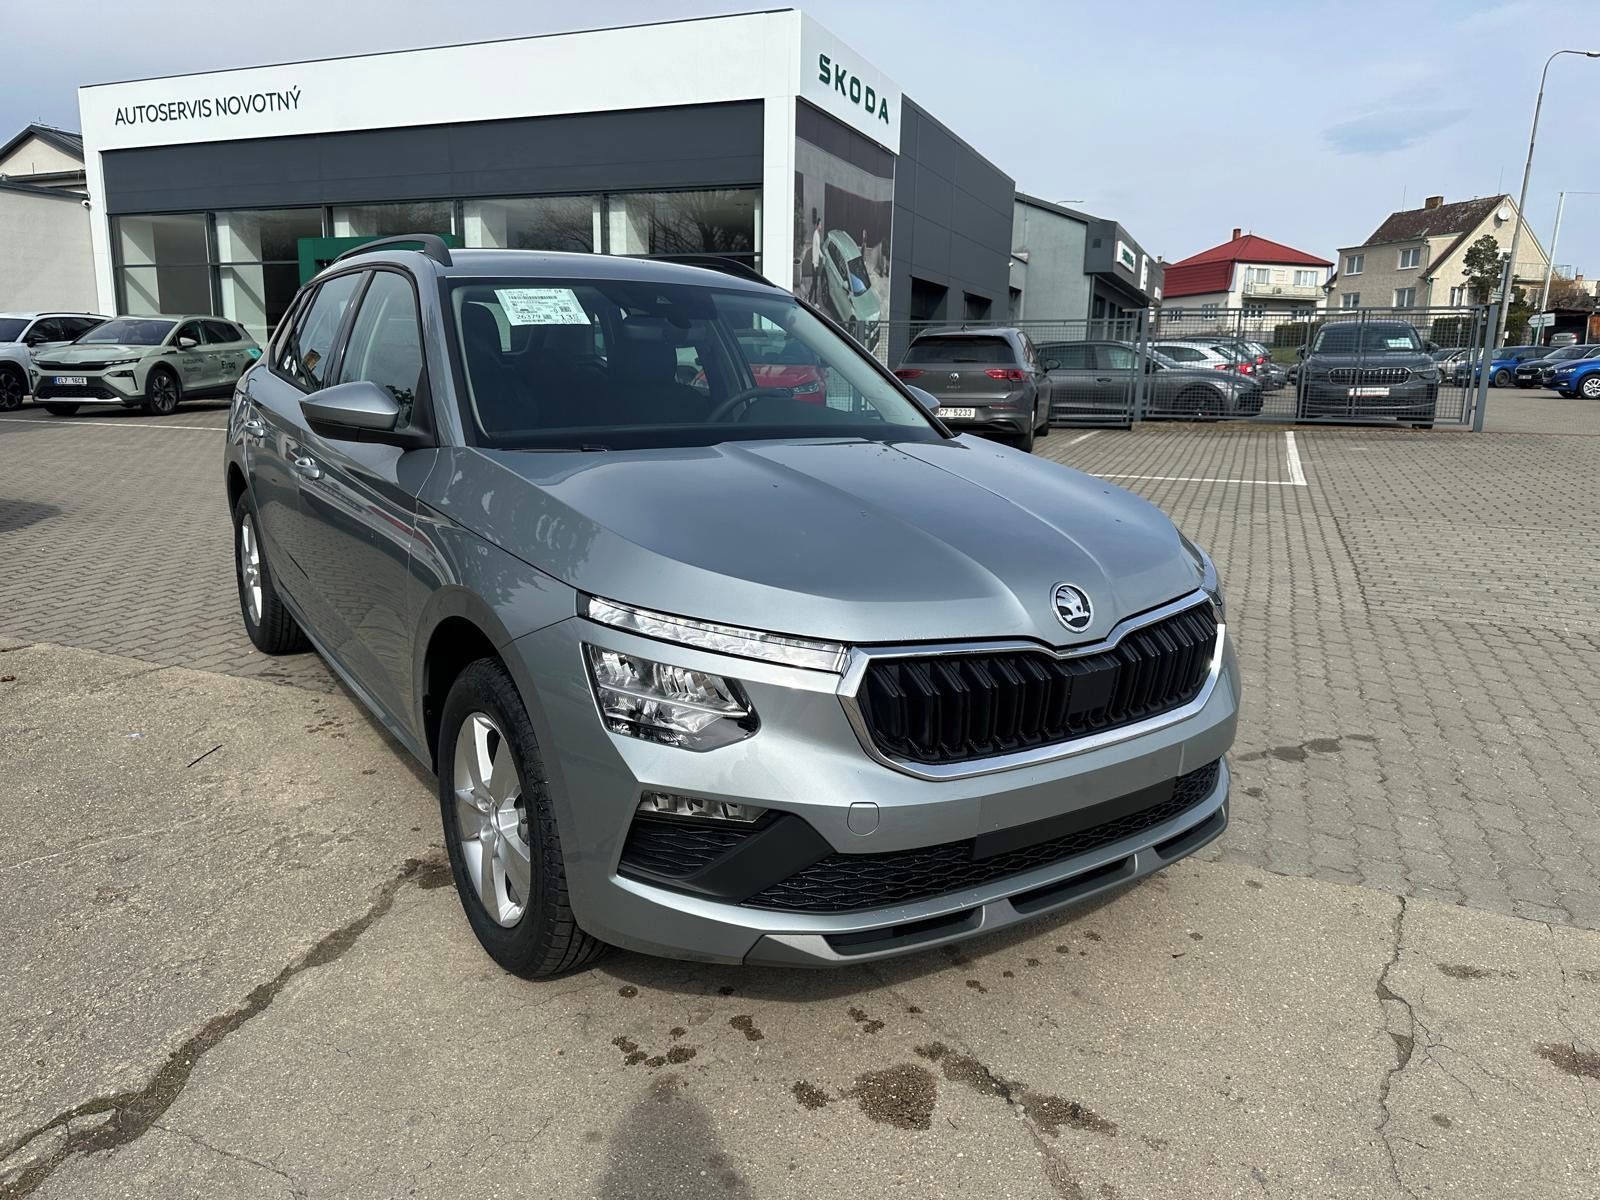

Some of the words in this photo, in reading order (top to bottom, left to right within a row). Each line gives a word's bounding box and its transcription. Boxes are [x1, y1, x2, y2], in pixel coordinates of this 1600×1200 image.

[114, 98, 212, 126] AUTOSERVIS
[215, 85, 302, 117] NOVOTNÝ
[953, 408, 972, 417] 5233
